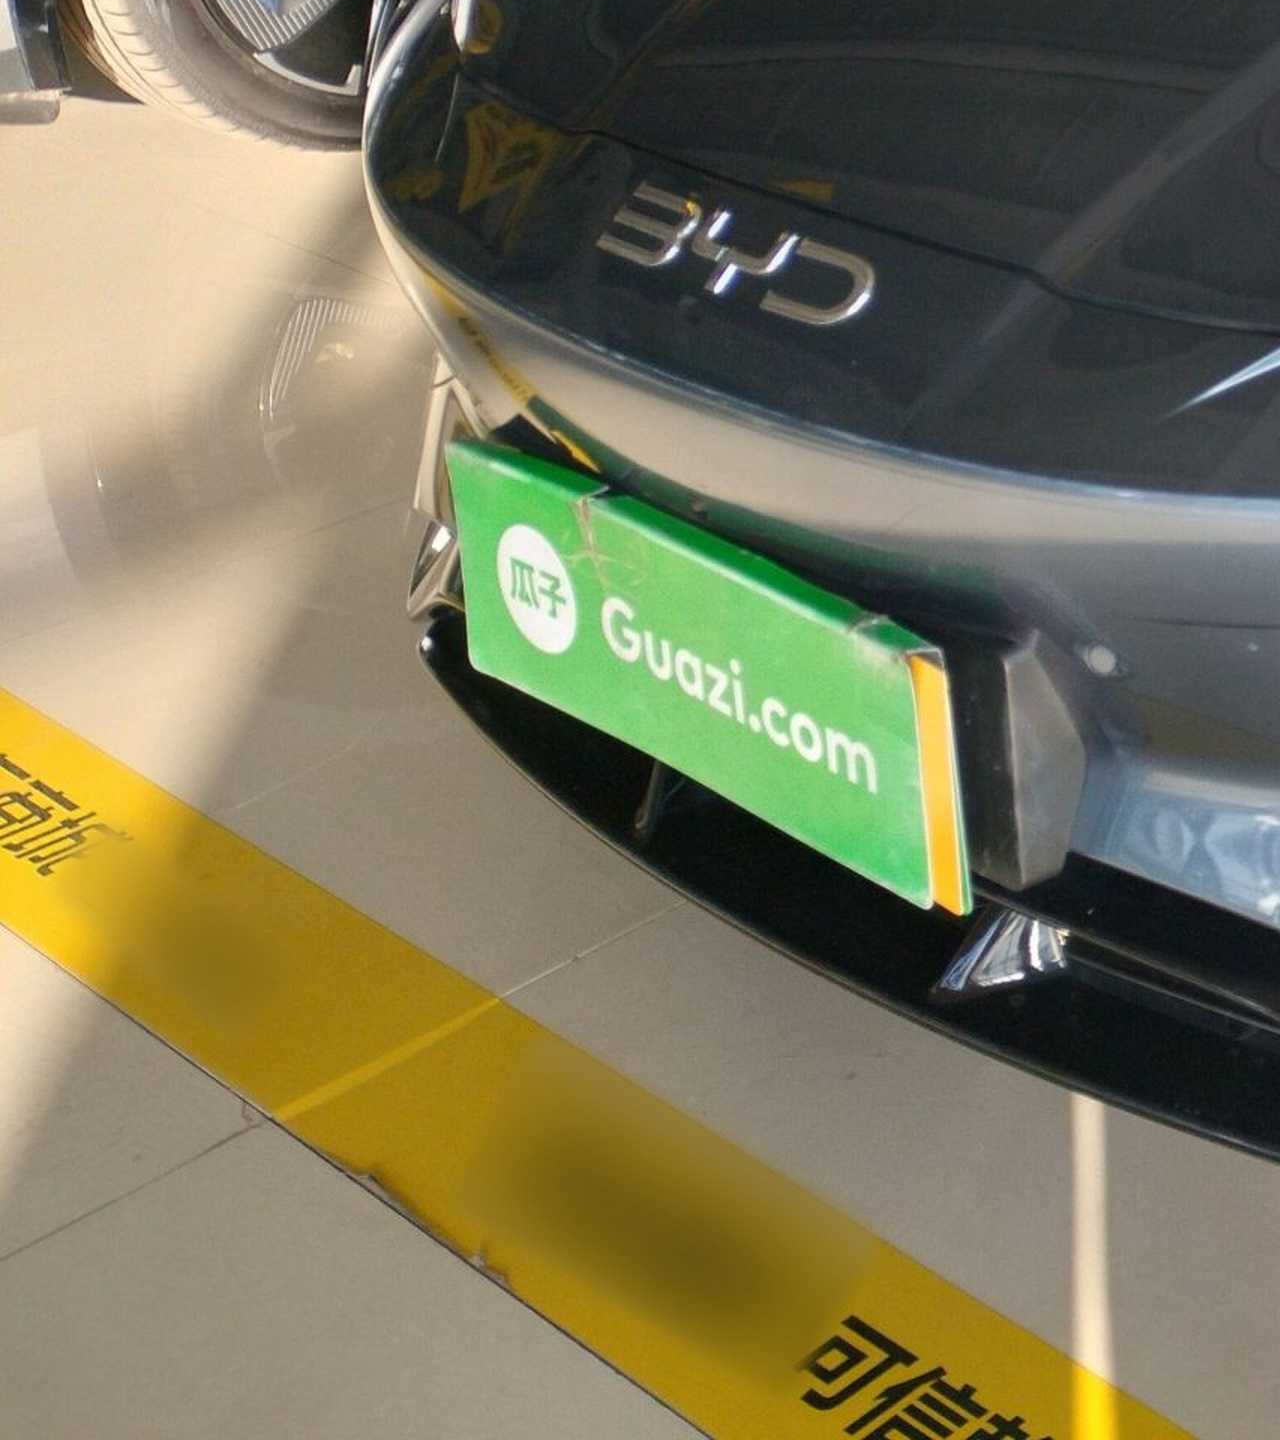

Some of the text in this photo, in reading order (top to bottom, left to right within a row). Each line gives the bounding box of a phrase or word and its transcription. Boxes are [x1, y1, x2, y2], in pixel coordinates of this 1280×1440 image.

[596, 180, 876, 326] BYD
[509, 556, 568, 620] 瓜子
[601, 595, 878, 794] Guazi.com
[795, 1315, 1054, 1440] 可信
